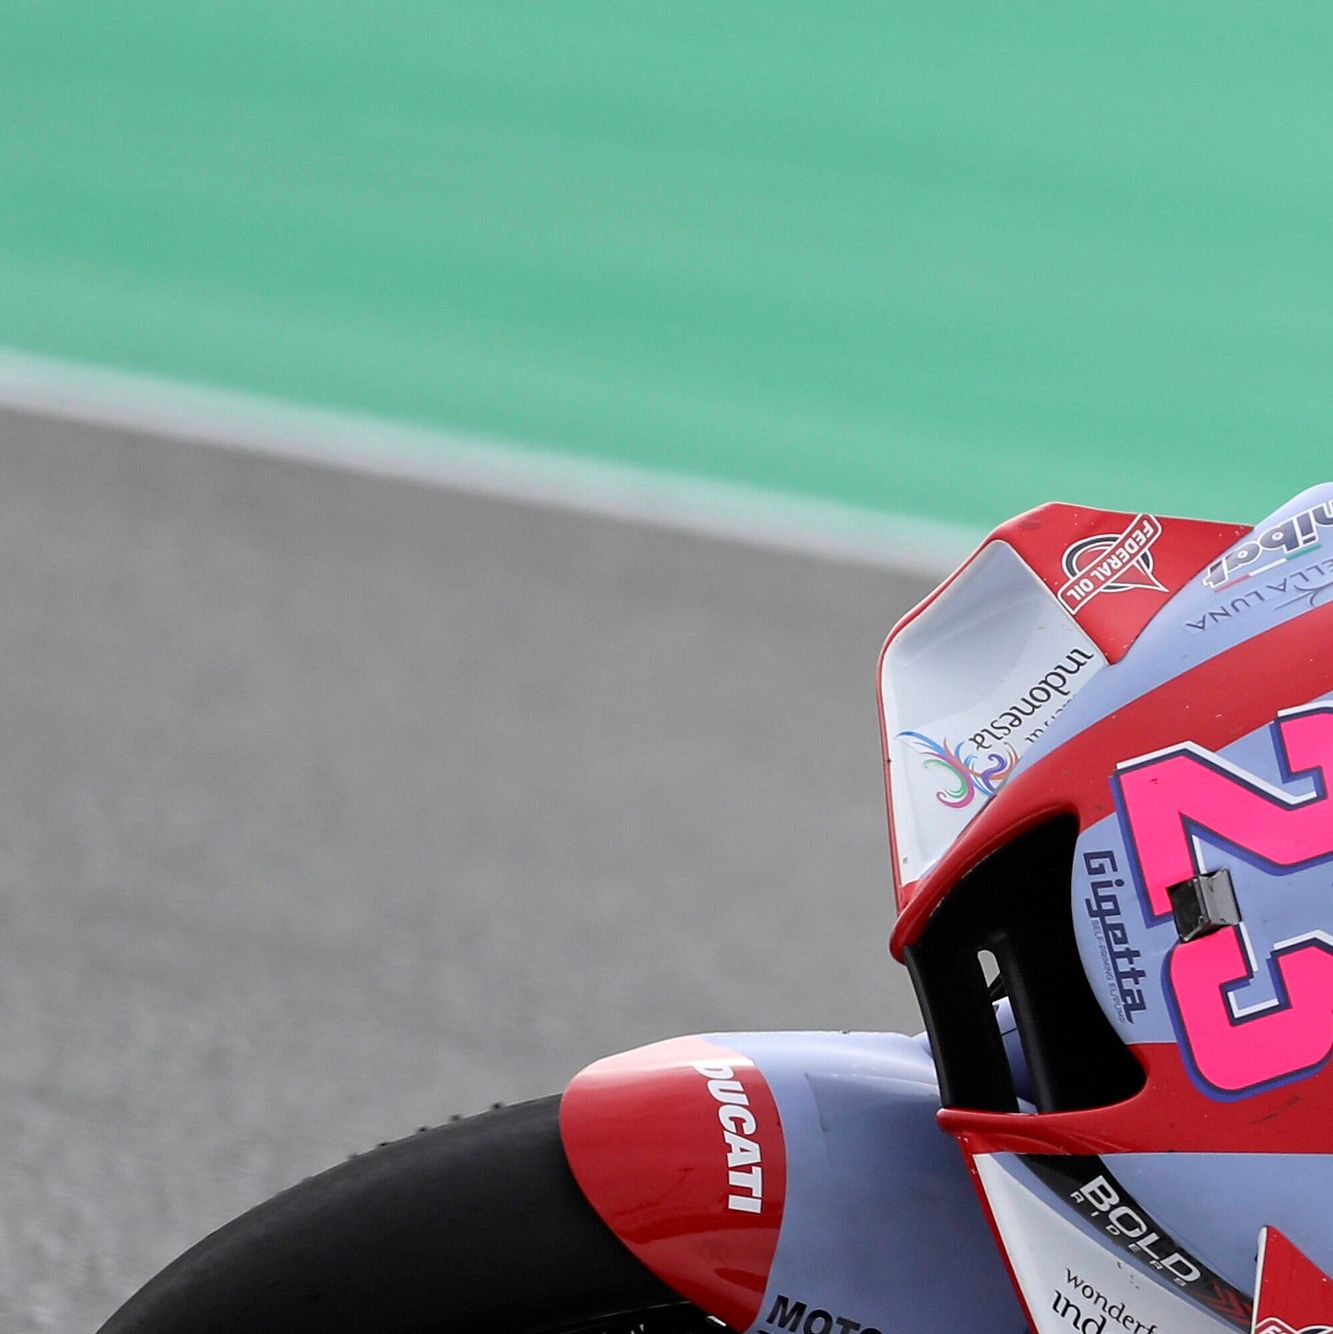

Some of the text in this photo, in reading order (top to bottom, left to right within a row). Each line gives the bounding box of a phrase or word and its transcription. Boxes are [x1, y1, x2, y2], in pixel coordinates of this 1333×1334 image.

[1060, 514, 1157, 610] FEDERAL OIL
[1185, 590, 1266, 630] LUNA
[969, 648, 1095, 750] indonesia
[1083, 850, 1146, 1024] Gigetta
[691, 1058, 764, 1214] DUCATI
[1070, 1191, 1187, 1287] RIDERS
[1079, 1175, 1201, 1282] BOLD
